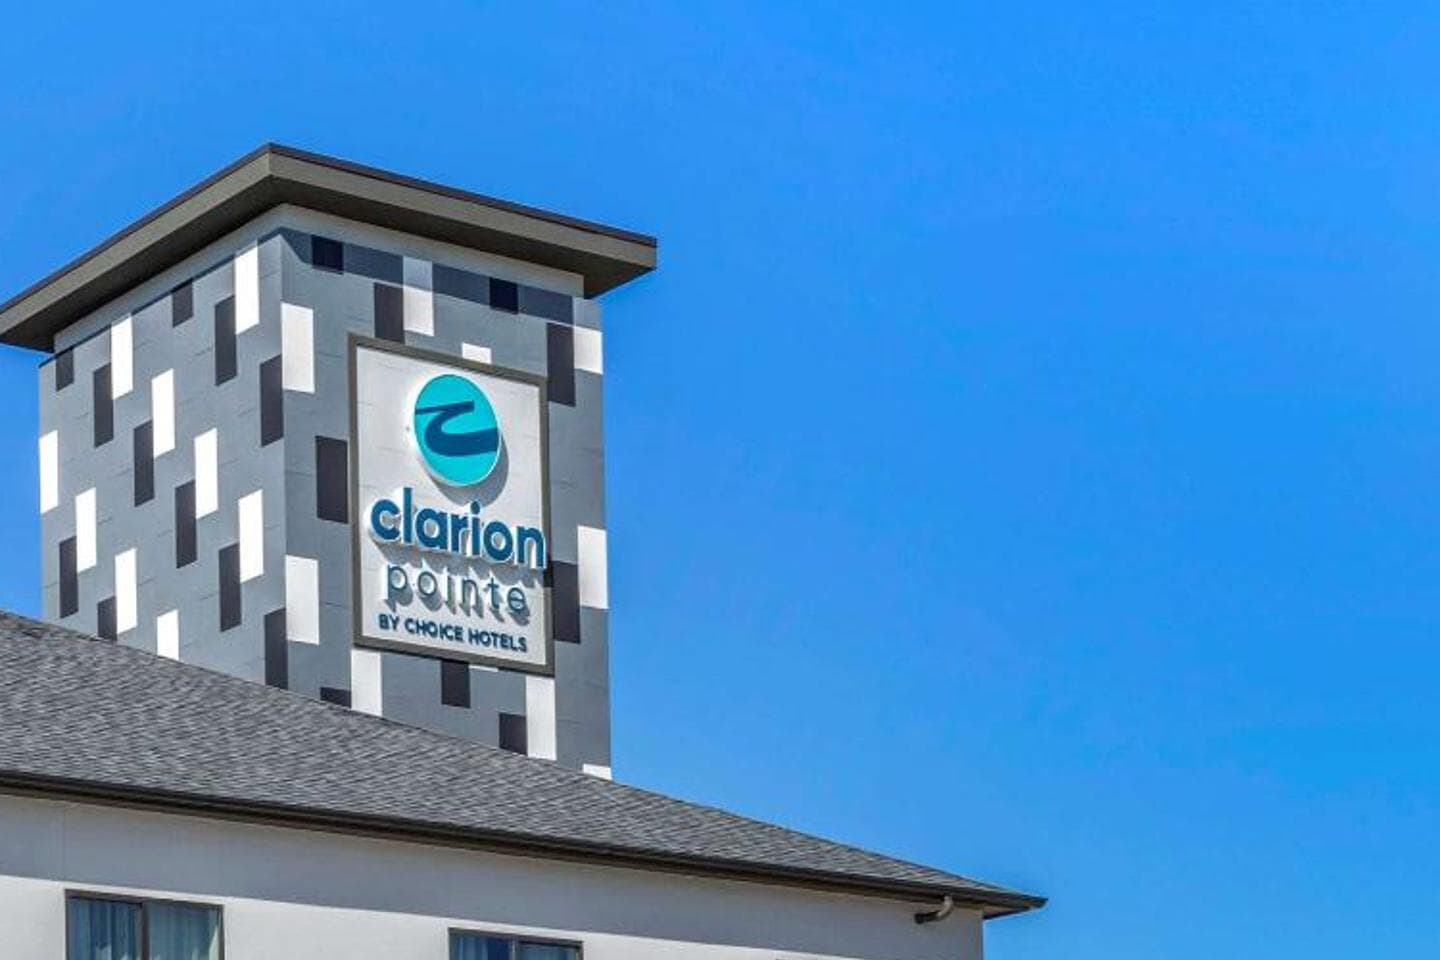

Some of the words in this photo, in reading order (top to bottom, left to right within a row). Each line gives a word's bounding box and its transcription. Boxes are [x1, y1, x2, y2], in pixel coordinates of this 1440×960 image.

[370, 487, 545, 567] clarion
[387, 564, 526, 613] pointe
[378, 613, 400, 631] BY
[404, 618, 464, 643] CHOICE
[468, 627, 528, 652] HOTELS
